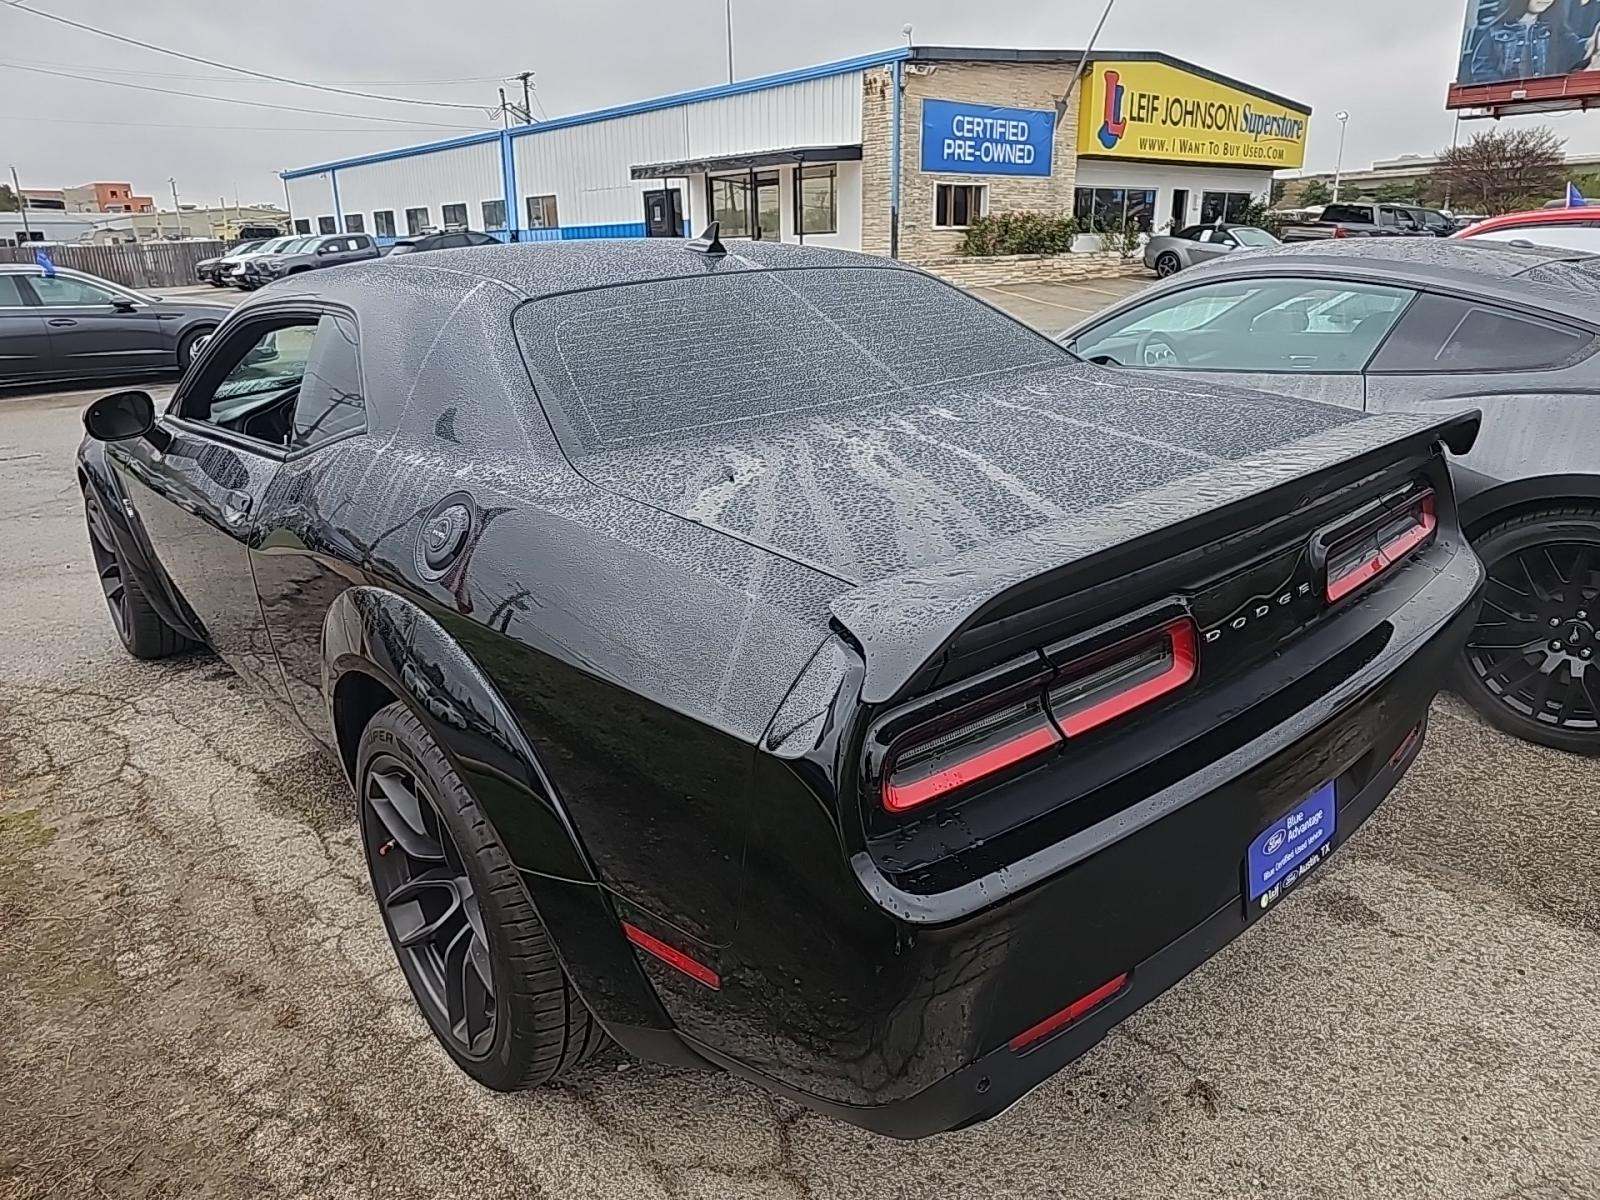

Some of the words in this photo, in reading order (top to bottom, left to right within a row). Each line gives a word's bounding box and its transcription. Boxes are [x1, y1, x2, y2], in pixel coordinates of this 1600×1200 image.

[952, 114, 1029, 141] CERTIFIED
[1129, 91, 1160, 124] LEIF
[1161, 97, 1239, 131] JOHNSON
[1240, 102, 1304, 142] Superstore
[943, 138, 1035, 164] PRE-OWNED
[1179, 138, 1206, 155] WANT
[1208, 141, 1220, 155] TO
[1222, 142, 1241, 157] BUY
[1205, 582, 1311, 643] DODGE
[1286, 811, 1304, 829] Blue
[1287, 809, 1324, 843] Advantage
[1263, 867, 1276, 881] Blue
[1275, 849, 1296, 871] Certified
[1294, 839, 1308, 855] Used
[1307, 828, 1324, 846] Vehicle
[1298, 854, 1321, 877] Austin,
[1320, 841, 1331, 857] TX
